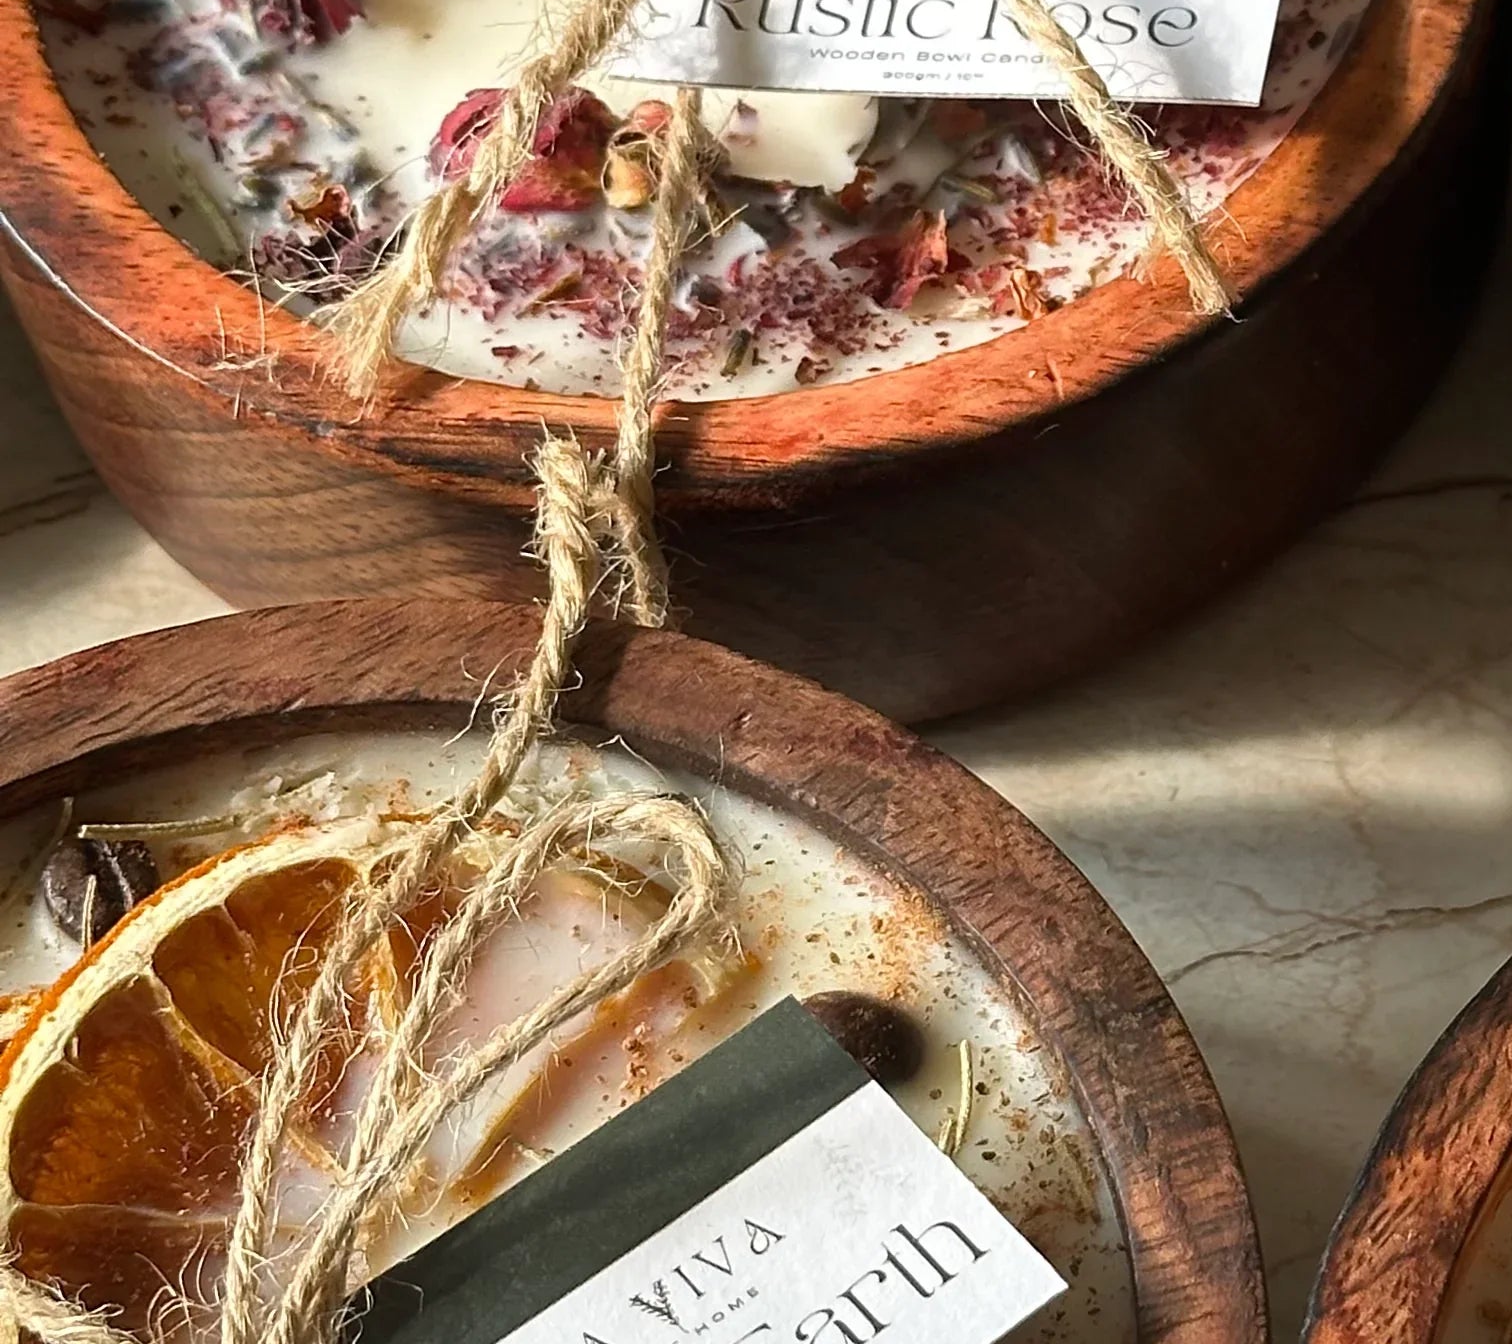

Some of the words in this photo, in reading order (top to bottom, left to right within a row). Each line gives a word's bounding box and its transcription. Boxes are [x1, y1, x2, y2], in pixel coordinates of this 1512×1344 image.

[809, 47, 905, 62] Wooden
[916, 50, 972, 63] Bowl
[628, 1218, 787, 1334] VIVA
[694, 1286, 759, 1337] HOME
